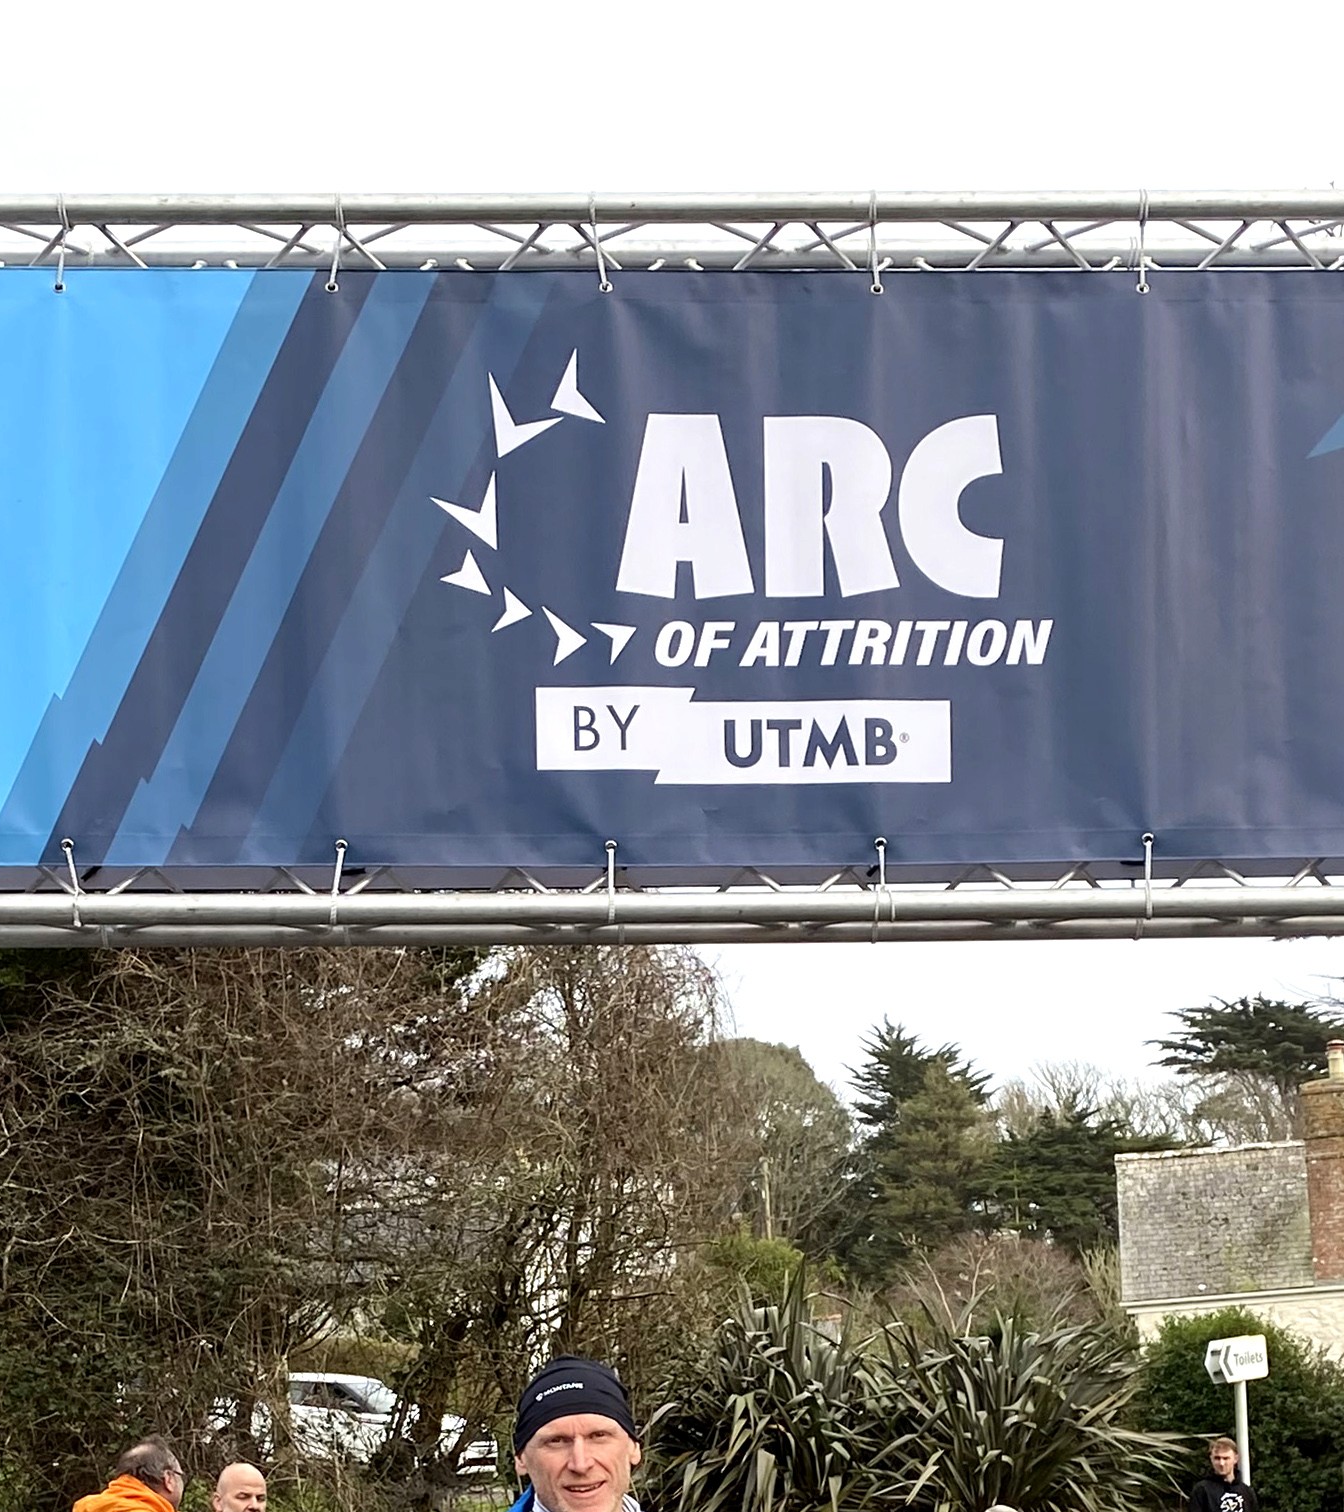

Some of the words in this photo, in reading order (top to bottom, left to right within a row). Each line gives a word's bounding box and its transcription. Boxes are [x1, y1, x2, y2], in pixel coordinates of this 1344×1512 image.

[616, 412, 1005, 600] ARC
[654, 619, 735, 667] OF
[739, 618, 1053, 667] ATTRITION
[574, 703, 640, 752] BY
[1233, 1352, 1264, 1366] Toilets
